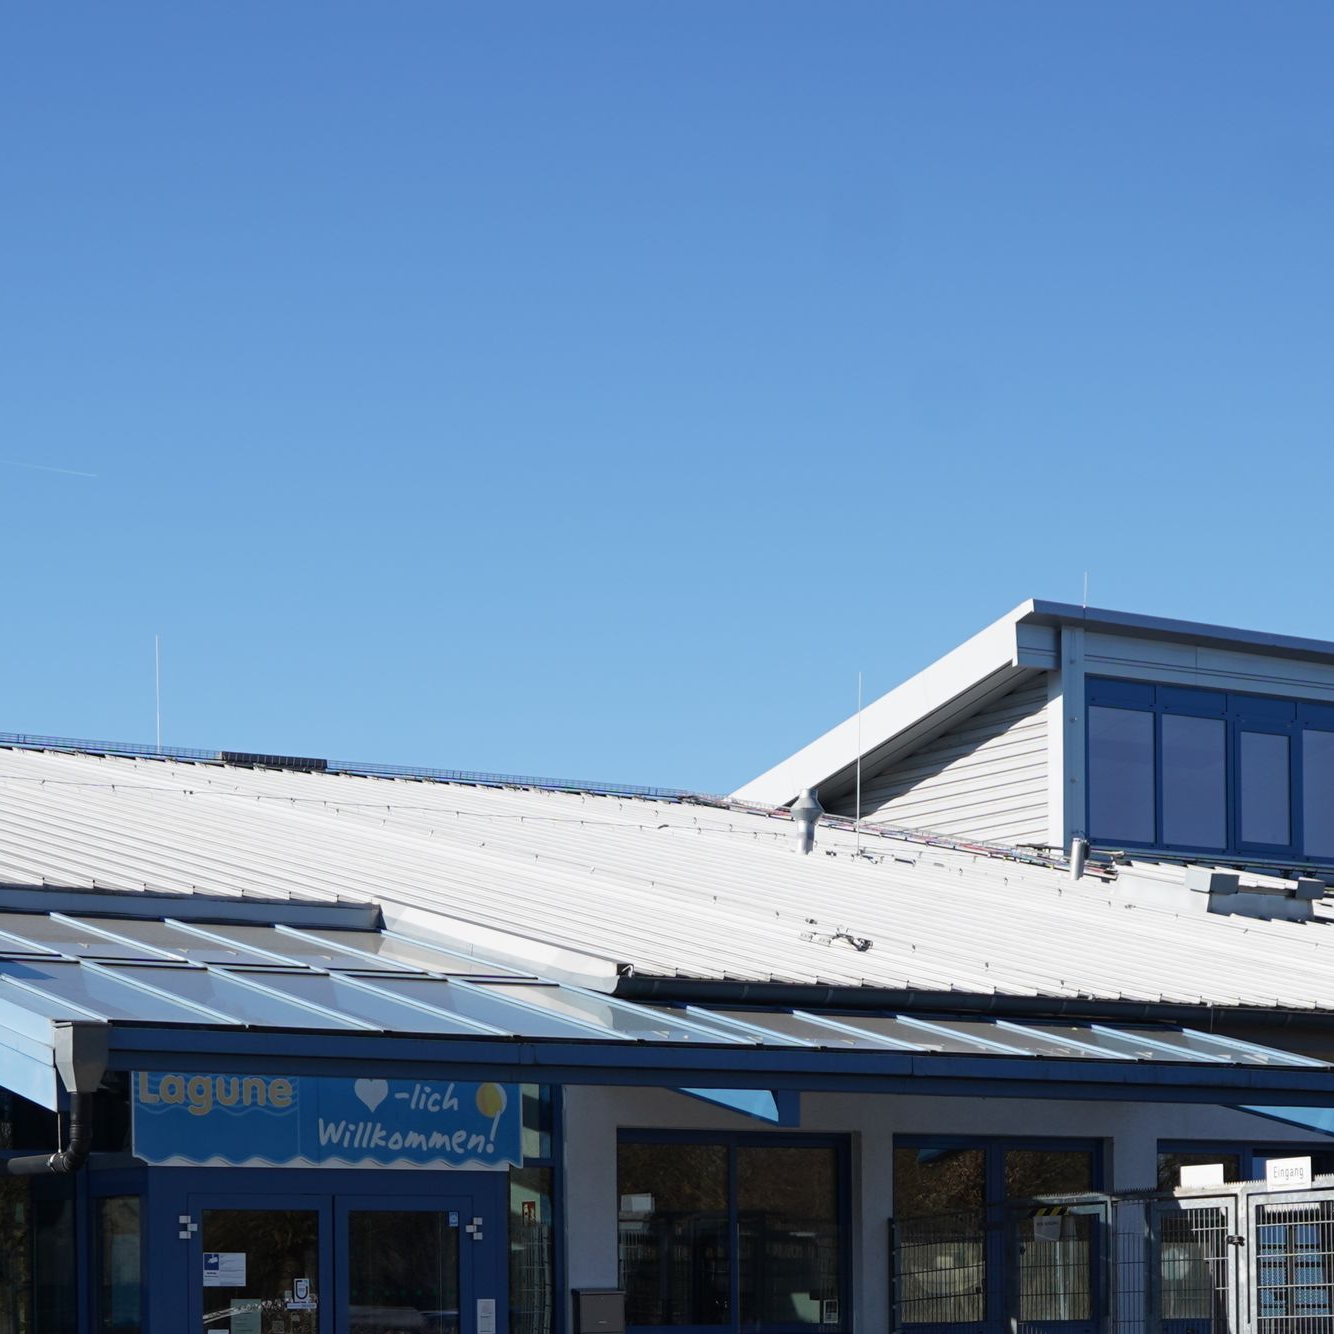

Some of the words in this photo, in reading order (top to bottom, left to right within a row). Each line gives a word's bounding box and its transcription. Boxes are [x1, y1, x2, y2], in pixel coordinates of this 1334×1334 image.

[137, 1071, 293, 1116] Lagune
[394, 1082, 459, 1112] -lich
[318, 1110, 501, 1154] Willkommen!
[1273, 1166, 1304, 1181] Eingang
